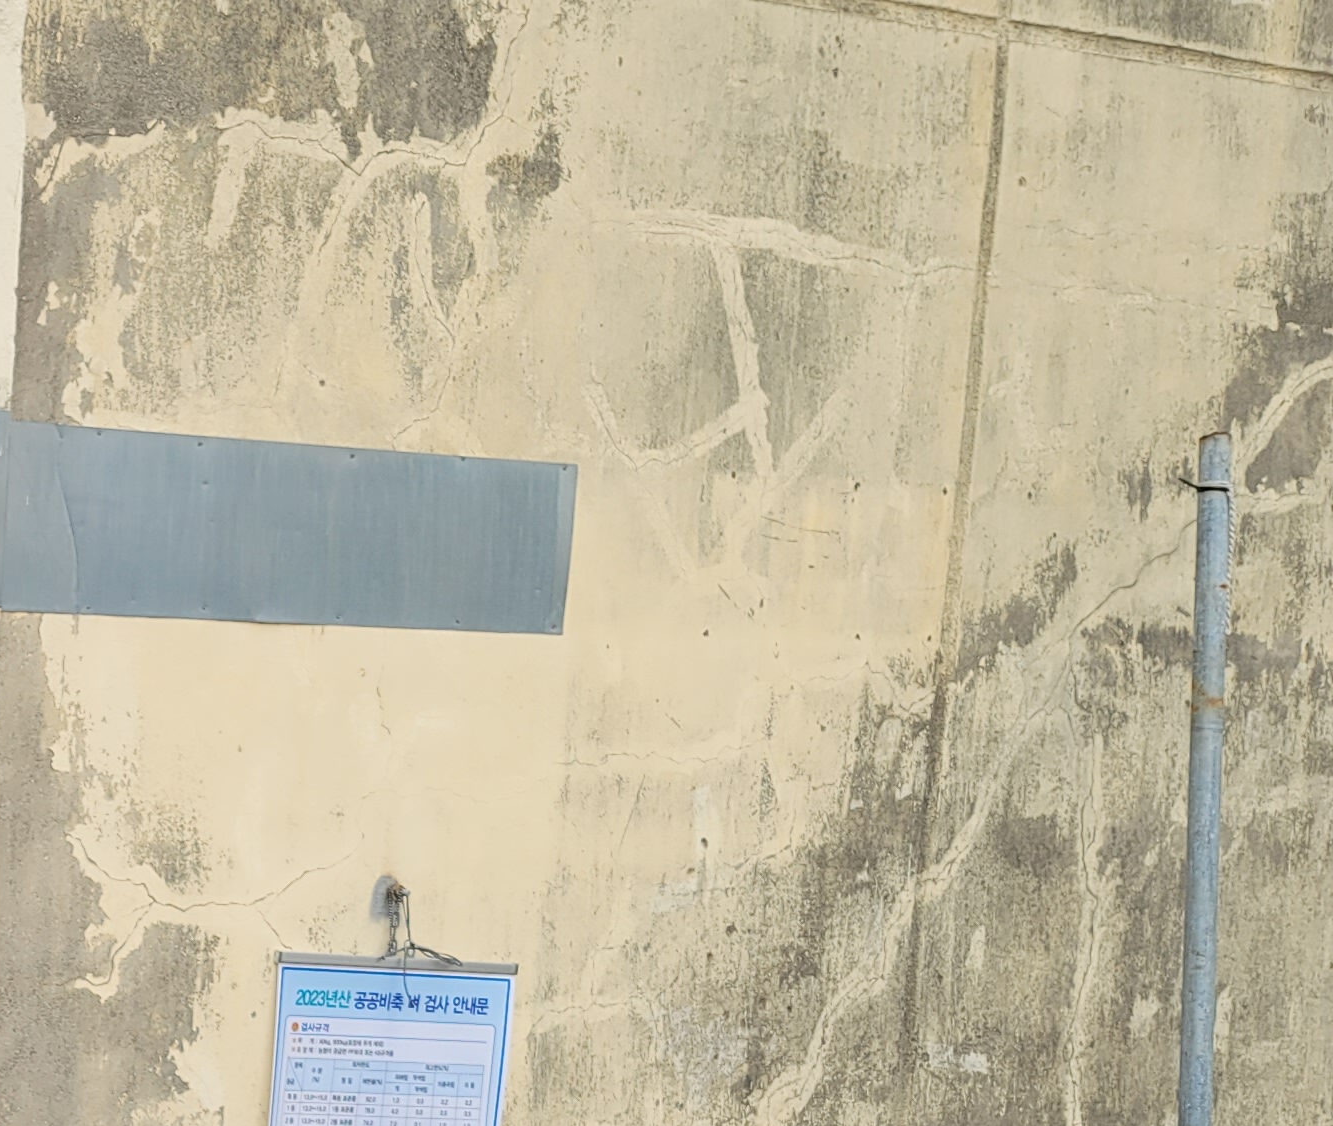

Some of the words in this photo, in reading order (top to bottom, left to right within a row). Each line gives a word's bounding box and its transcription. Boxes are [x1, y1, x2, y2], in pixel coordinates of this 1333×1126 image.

[295, 989, 351, 1008] 2023년산
[354, 991, 404, 1012] 공공비축
[408, 993, 420, 1012] 벼
[424, 994, 449, 1014] 검사
[453, 996, 489, 1015] 안내문
